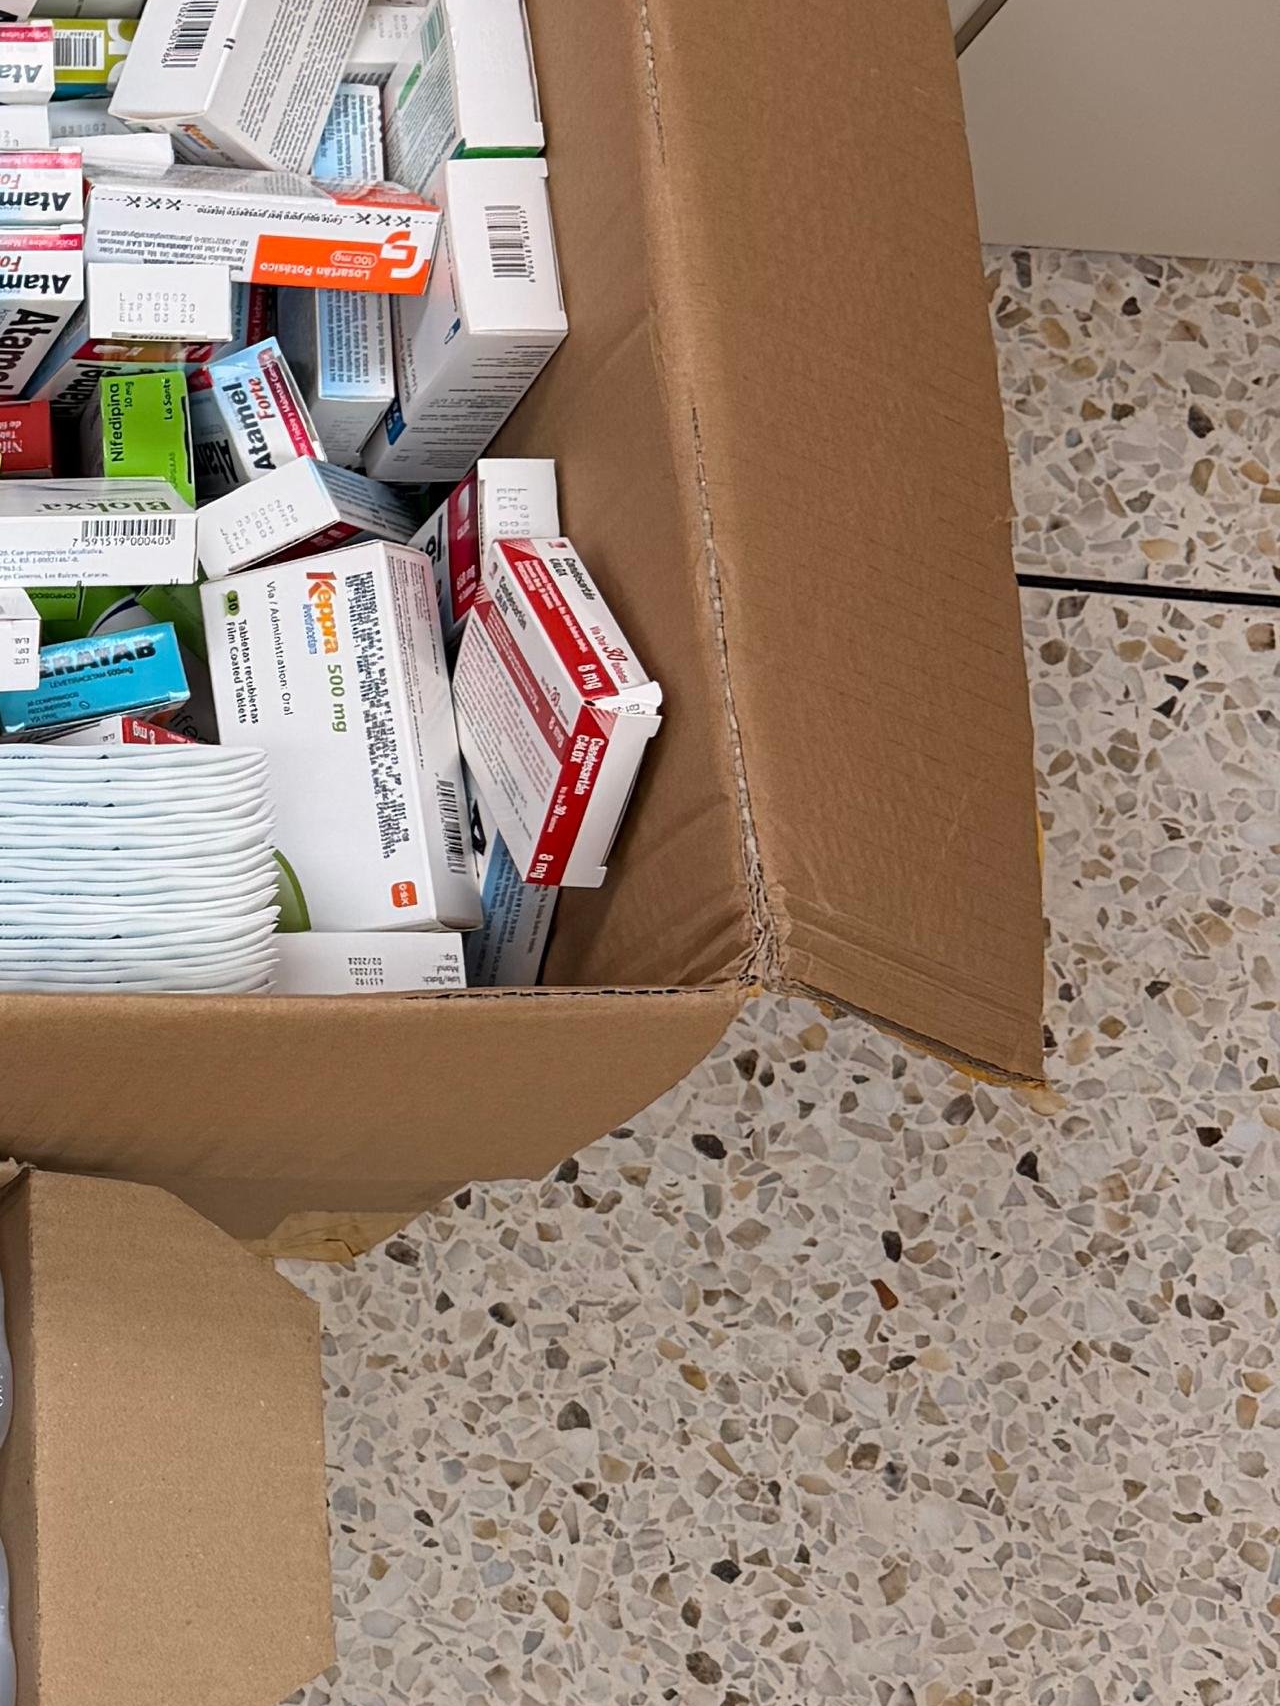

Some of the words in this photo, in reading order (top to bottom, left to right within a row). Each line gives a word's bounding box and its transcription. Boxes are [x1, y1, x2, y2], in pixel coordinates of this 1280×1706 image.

[259, 263, 313, 276] Potásico
[316, 267, 371, 280] Losartán
[354, 255, 376, 265] 100
[249, 377, 276, 420] Forte
[110, 383, 124, 462] Nifedipina
[221, 381, 277, 471] Atamel
[227, 591, 239, 612] 30
[238, 619, 251, 663] Tabletas
[306, 571, 339, 655] Keppra
[226, 621, 236, 643] Film
[41, 641, 158, 679] ERATAB
[327, 665, 346, 698] 500
[281, 694, 294, 716] Oral
[332, 700, 347, 733] mg
